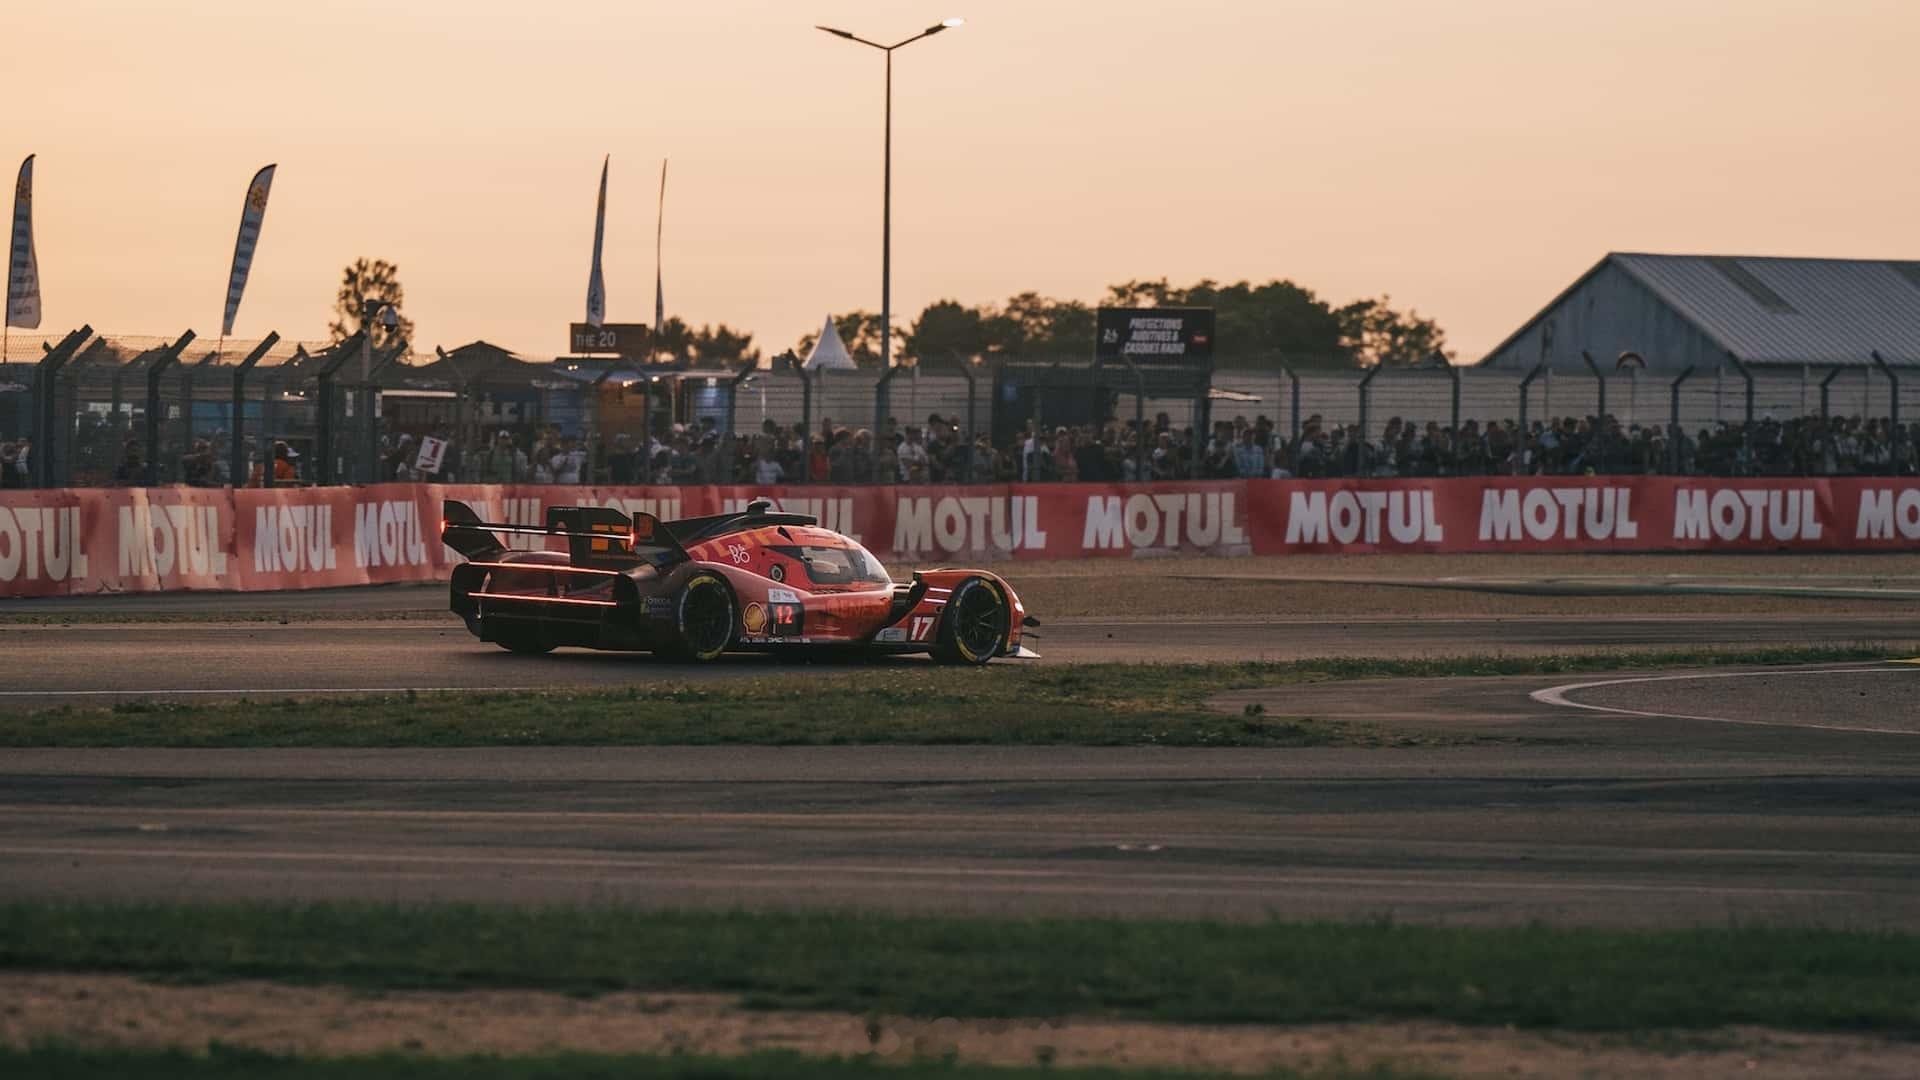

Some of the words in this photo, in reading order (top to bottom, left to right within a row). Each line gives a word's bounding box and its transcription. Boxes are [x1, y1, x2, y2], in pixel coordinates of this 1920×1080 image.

[118, 504, 227, 577] MOTUL
[254, 504, 336, 573] MOTUL
[354, 500, 428, 568] MOTUL
[893, 496, 1046, 553] MOTUL
[1082, 493, 1243, 549] MOTUL
[1285, 490, 1443, 545] MOTUL
[1479, 488, 1638, 541] MOTUL
[1673, 488, 1822, 541] MOTUL
[776, 605, 793, 624] 12
[910, 616, 937, 641] 17
